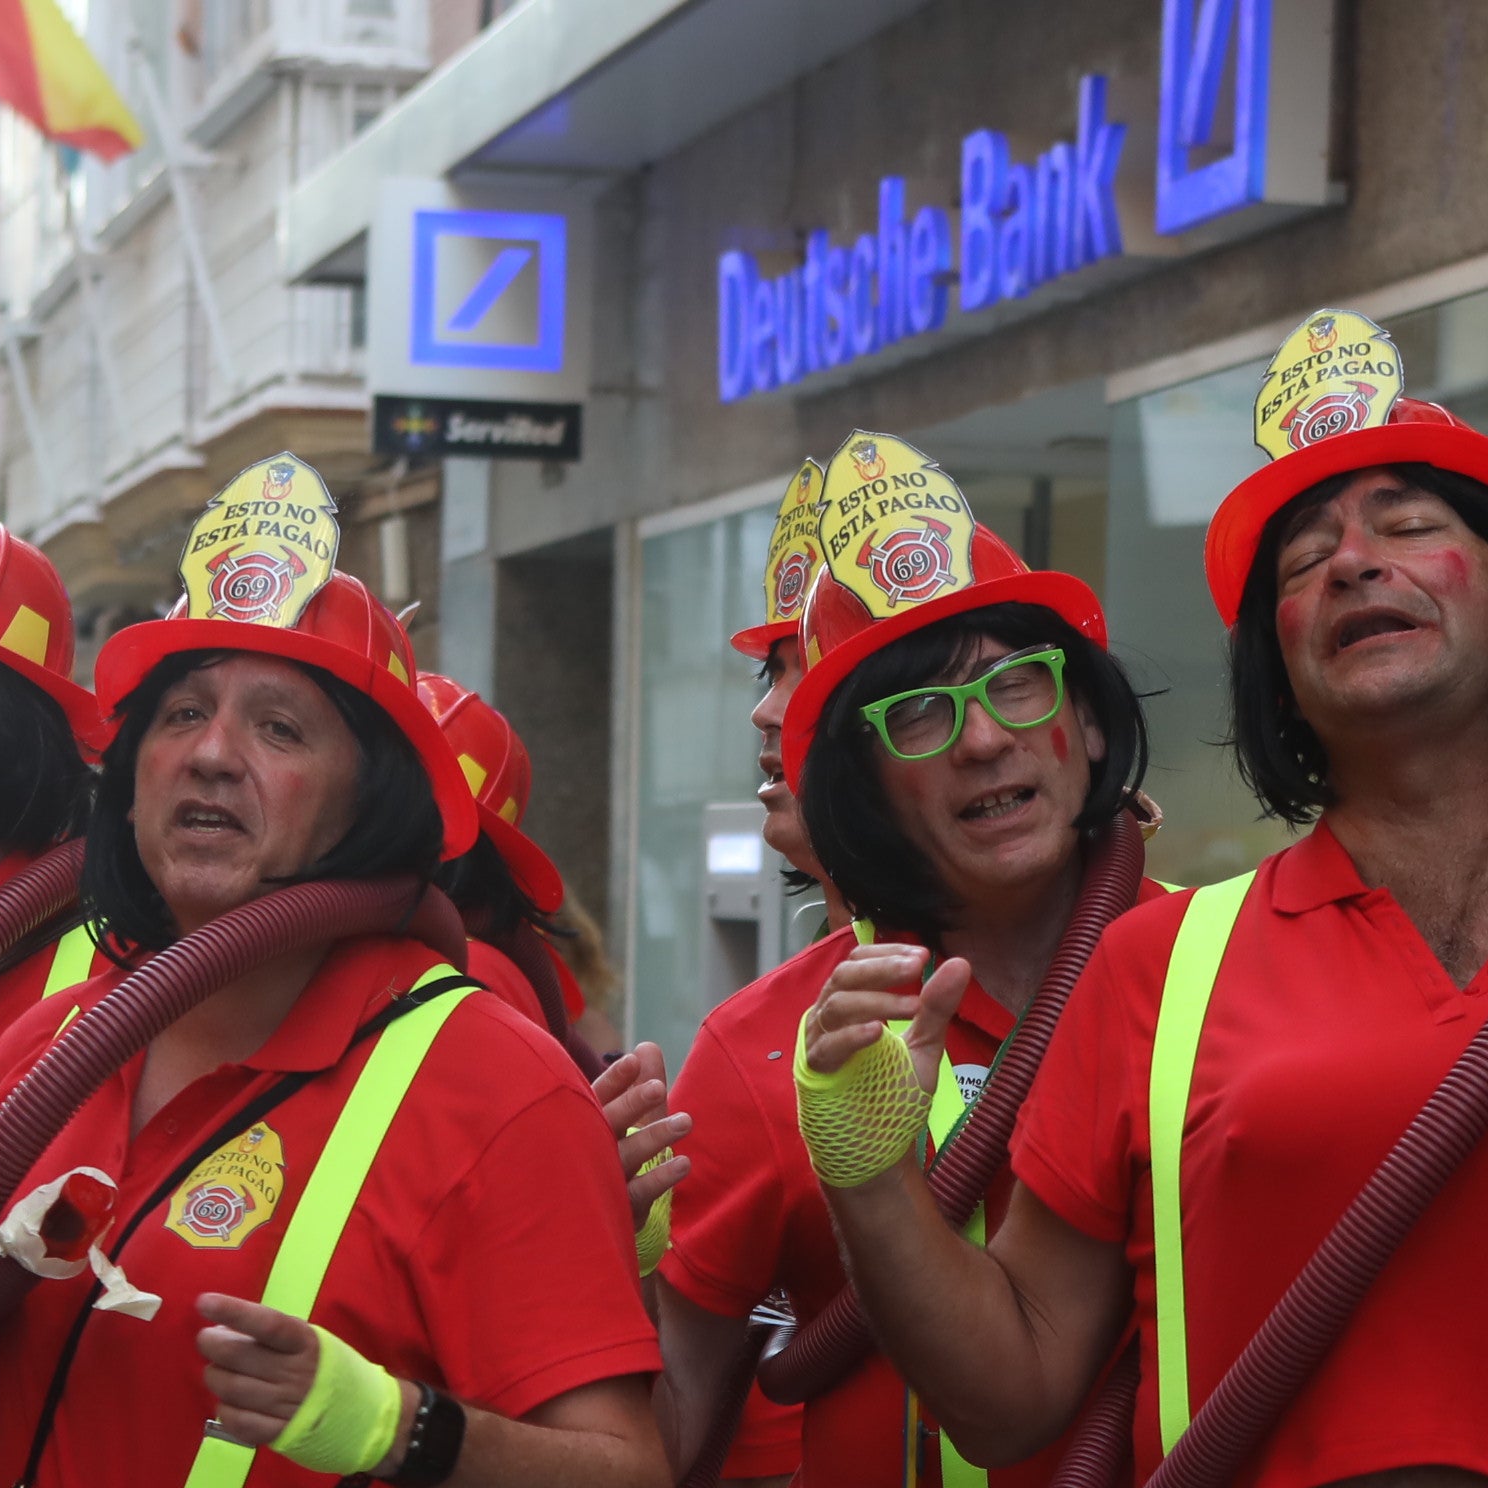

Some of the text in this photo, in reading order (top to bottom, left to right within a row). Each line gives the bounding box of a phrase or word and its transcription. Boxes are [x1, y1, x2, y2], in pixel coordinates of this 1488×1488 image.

[718, 73, 1128, 405] Deutsche Bank
[1280, 342, 1372, 386] ESTO NO
[1261, 360, 1395, 426] ESTÁ PAGAO
[1309, 411, 1347, 441] 69
[838, 472, 929, 518] ESTO NO
[223, 501, 318, 526] ESTO NO
[780, 504, 806, 531] ESTO
[829, 492, 962, 560] ESTÁ PAGAO
[191, 517, 330, 561] ESTÁ PAGAO
[793, 520, 821, 540] PAGA
[892, 550, 931, 581] 69
[229, 574, 272, 600] 69
[250, 1155, 273, 1175] NO
[225, 1165, 276, 1204] PAGAO
[196, 1200, 228, 1222] 69
